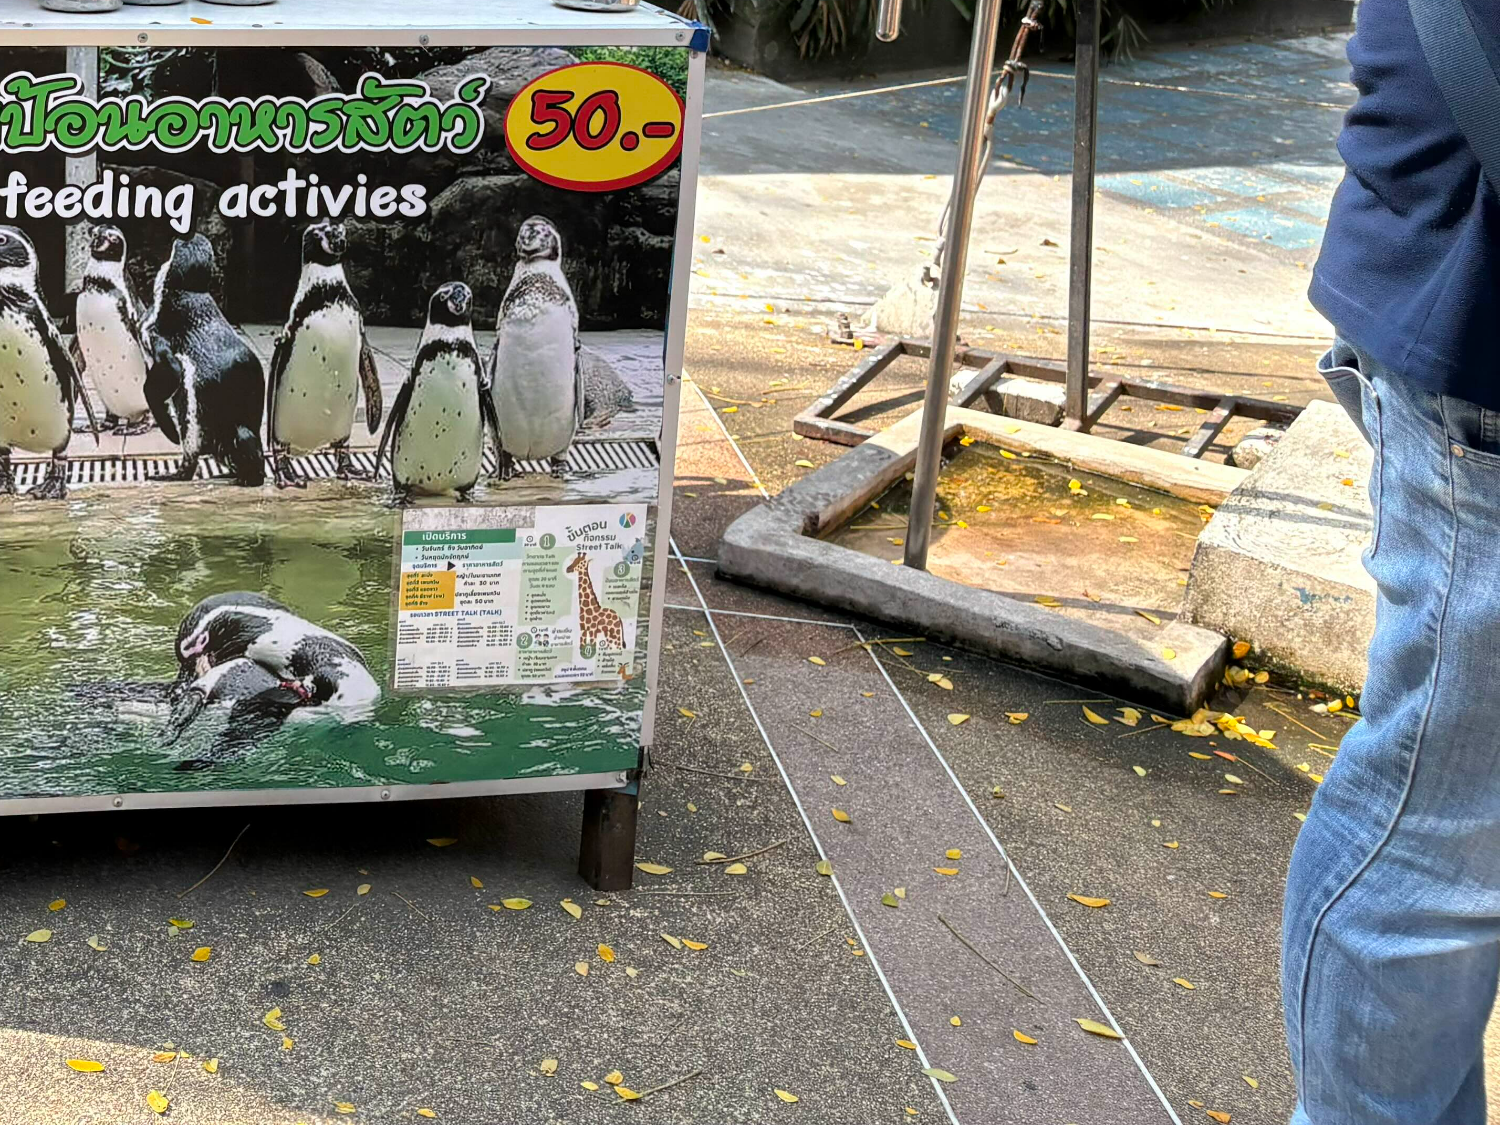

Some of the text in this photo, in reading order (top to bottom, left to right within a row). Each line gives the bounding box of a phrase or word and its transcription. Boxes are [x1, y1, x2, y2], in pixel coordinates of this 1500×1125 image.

[526, 88, 676, 152] 50.-
[218, 168, 428, 219] activies
[576, 543, 603, 551] Street
